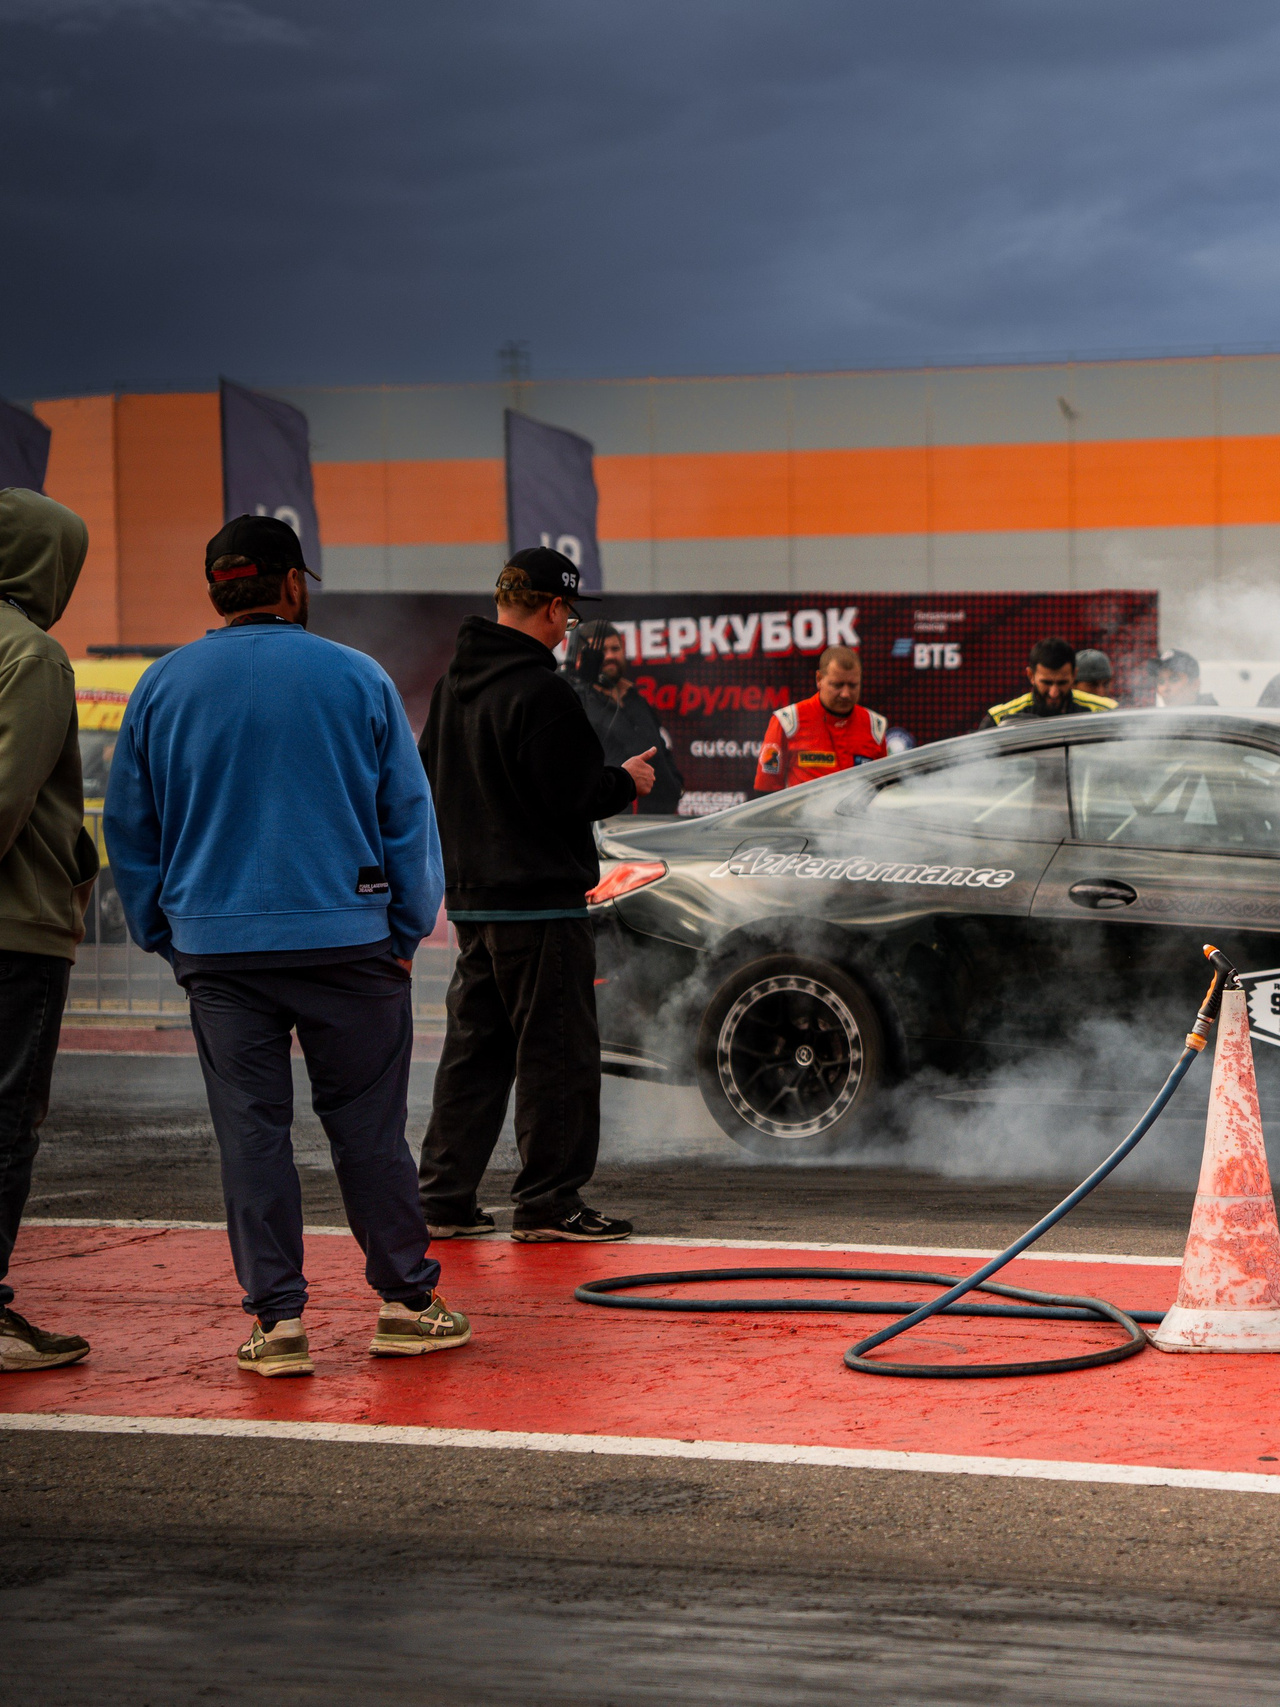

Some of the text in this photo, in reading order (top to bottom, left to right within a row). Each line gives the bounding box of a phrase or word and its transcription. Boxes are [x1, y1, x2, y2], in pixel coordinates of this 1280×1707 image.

[561, 572, 576, 588] 95
[560, 607, 860, 662] ПЕРКУБОК
[914, 643, 962, 669] ВТБ
[690, 739, 762, 758] auto.ru
